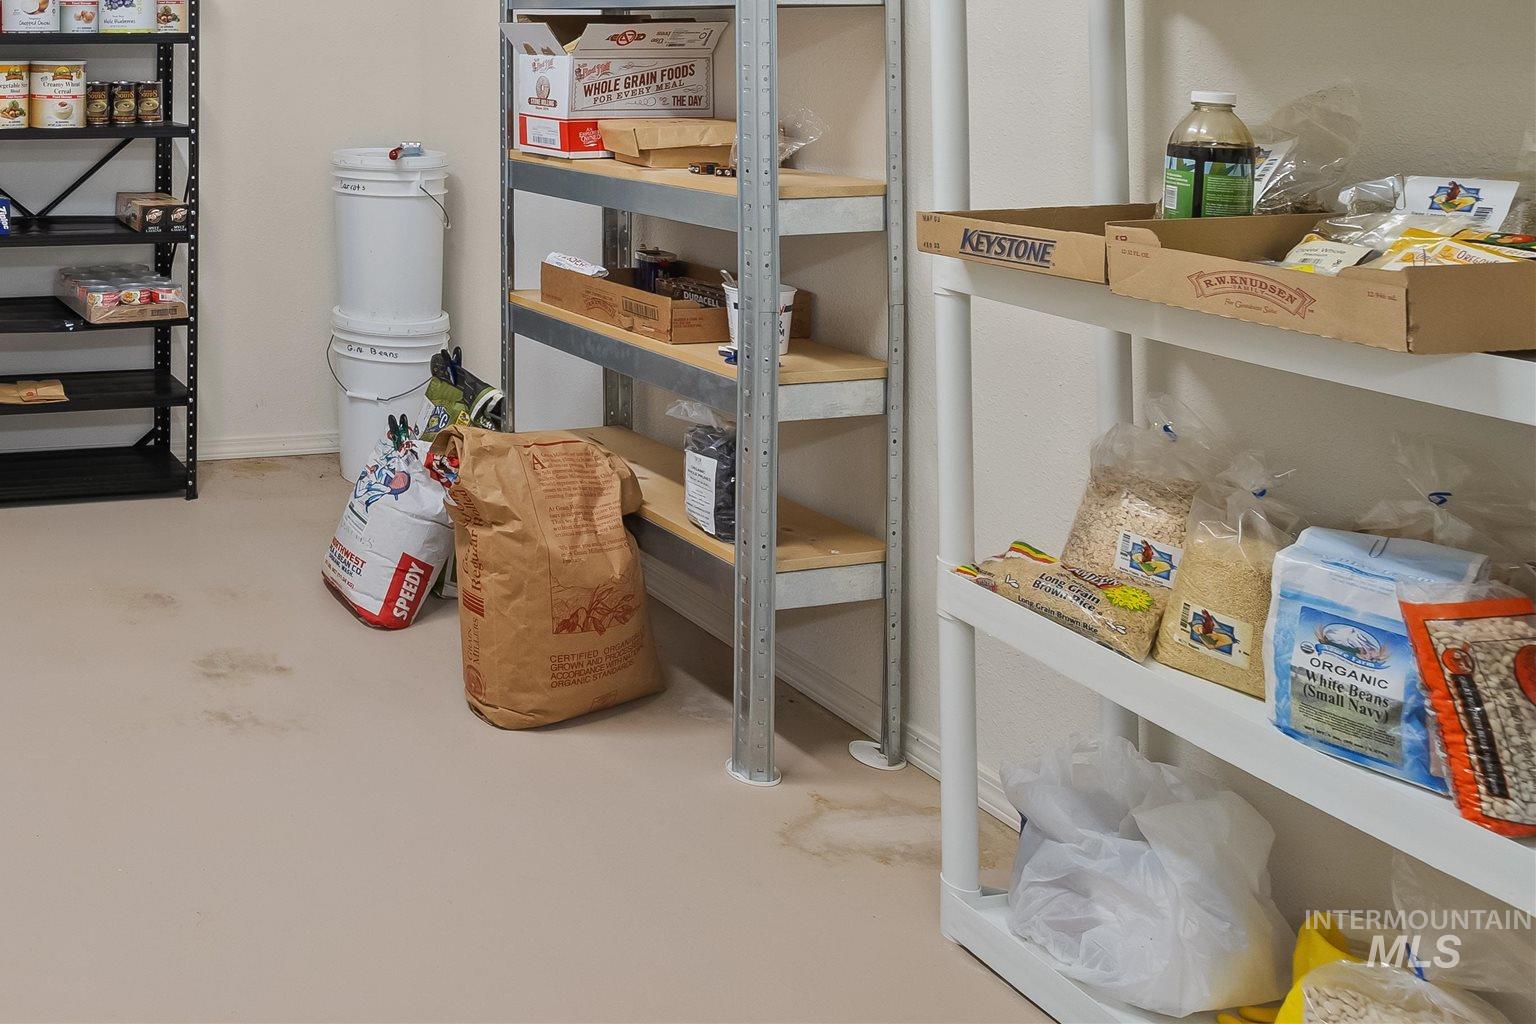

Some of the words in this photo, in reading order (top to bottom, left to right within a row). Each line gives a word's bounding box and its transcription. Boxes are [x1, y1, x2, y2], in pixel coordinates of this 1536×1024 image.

[584, 78, 620, 98] WHOLE
[624, 72, 657, 91] GRAIN
[660, 63, 695, 83] FOODS
[593, 96, 612, 105] FOR
[616, 87, 652, 100] EVERY
[655, 79, 684, 92] MEAL
[672, 95, 687, 107] THE
[687, 95, 704, 107] DAY
[960, 228, 1054, 264] KEYSTONE
[683, 291, 719, 308] DURACELL
[1232, 283, 1267, 294] FAMILY
[370, 347, 399, 359] Beans
[532, 453, 547, 471] A
[393, 561, 425, 621] SPEEDY
[1032, 580, 1068, 600] Brown
[1070, 595, 1096, 613] Rice
[1039, 573, 1066, 590] Long
[1068, 583, 1101, 605] Grain
[1018, 595, 1035, 608] Long
[1035, 602, 1055, 616] Grain
[1057, 611, 1081, 627] Brown
[1082, 622, 1098, 635] Rice
[550, 650, 599, 663] CERTIFIED
[550, 662, 584, 672] GROWN
[586, 657, 602, 667] AND
[550, 676, 591, 688] ORGANIC
[593, 660, 634, 681] STANDARDS
[551, 664, 605, 680] ACCORDANCE
[1310, 657, 1389, 690] ORGANIC
[1305, 669, 1345, 693] White
[1348, 684, 1389, 708] Beans
[1303, 683, 1344, 707] (Small
[1348, 698, 1389, 724] Navy)
